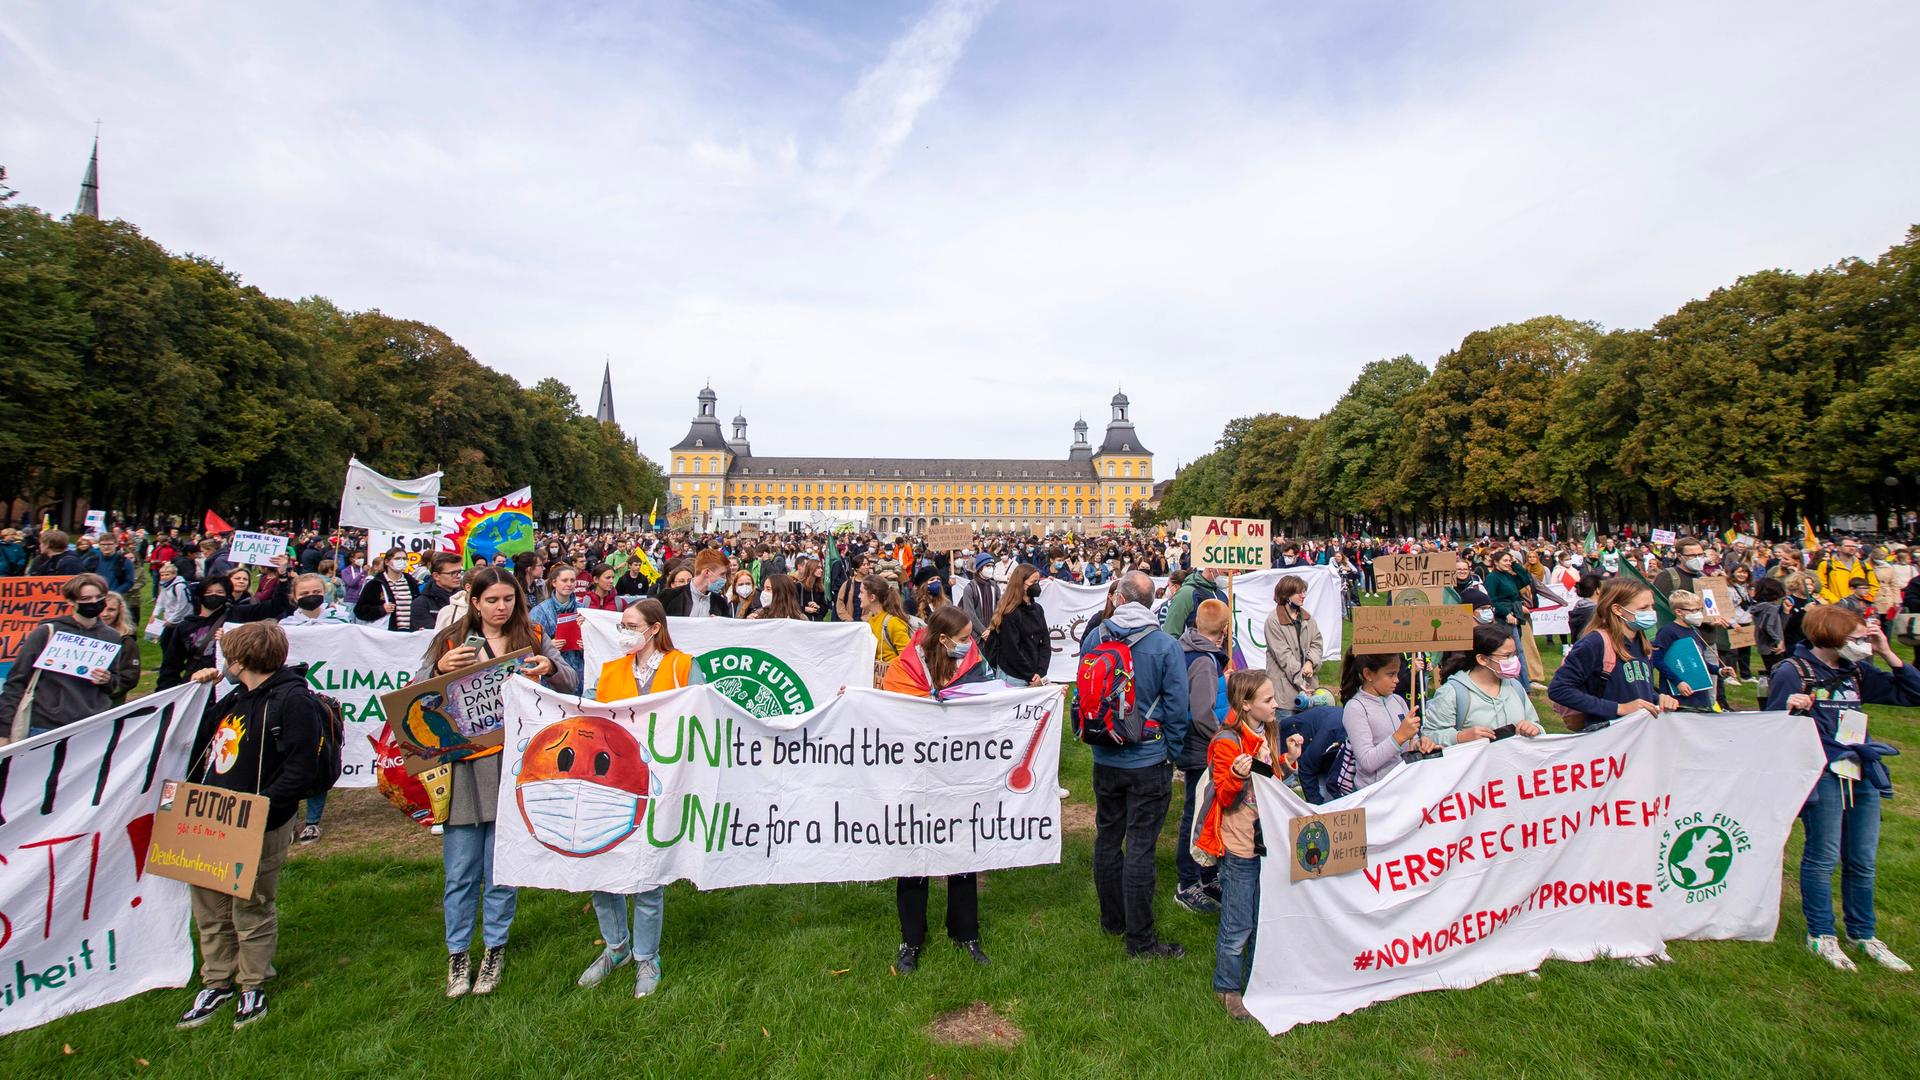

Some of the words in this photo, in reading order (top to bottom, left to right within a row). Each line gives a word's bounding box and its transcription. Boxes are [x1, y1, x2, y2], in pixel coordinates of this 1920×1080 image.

[1205, 519, 1242, 536] ACT
[1247, 523, 1264, 536] ON
[233, 540, 281, 556] PLANET
[391, 535, 406, 549] IS
[410, 537, 436, 552] ON
[249, 553, 257, 564] B
[1202, 545, 1263, 565] SCIENCE
[1394, 555, 1429, 572] KEIN
[1354, 607, 1392, 621] KLIMA
[56, 633, 88, 647] THERE
[89, 640, 98, 649] IS
[101, 643, 117, 653] NO
[1382, 629, 1425, 642] ZUKUNFT
[45, 646, 97, 663] PLANET
[94, 655, 107, 667] B
[304, 660, 418, 690] KLIMAB
[460, 669, 504, 695] LOSS
[709, 654, 753, 674] FOR
[757, 660, 806, 715] FUTUR
[466, 699, 504, 720] FINA
[647, 711, 762, 768] UNIte
[773, 727, 854, 767] behind
[861, 727, 904, 766] the
[913, 735, 1014, 764] science
[1418, 778, 1507, 829] KEINE
[1517, 752, 1628, 800] LEEREN
[185, 788, 237, 826] FUTUR
[646, 793, 759, 853] UNIte
[765, 804, 800, 858] for
[806, 820, 821, 844] a
[834, 800, 962, 845] healthier
[968, 801, 1052, 853] future
[1333, 813, 1359, 828] KEIN
[1332, 831, 1353, 844] GRAD
[1362, 810, 1582, 894] VERSPRECHEN
[1589, 794, 1671, 828] MEHR!
[1656, 830, 1671, 892] FRIDAYS
[1674, 811, 1703, 830] FOR
[1712, 813, 1751, 853] FUTURE
[1686, 880, 1728, 904] BONN
[1352, 879, 1654, 971] #NOMOREEMPTYPROMISE
[0, 928, 117, 1013] iheit!
